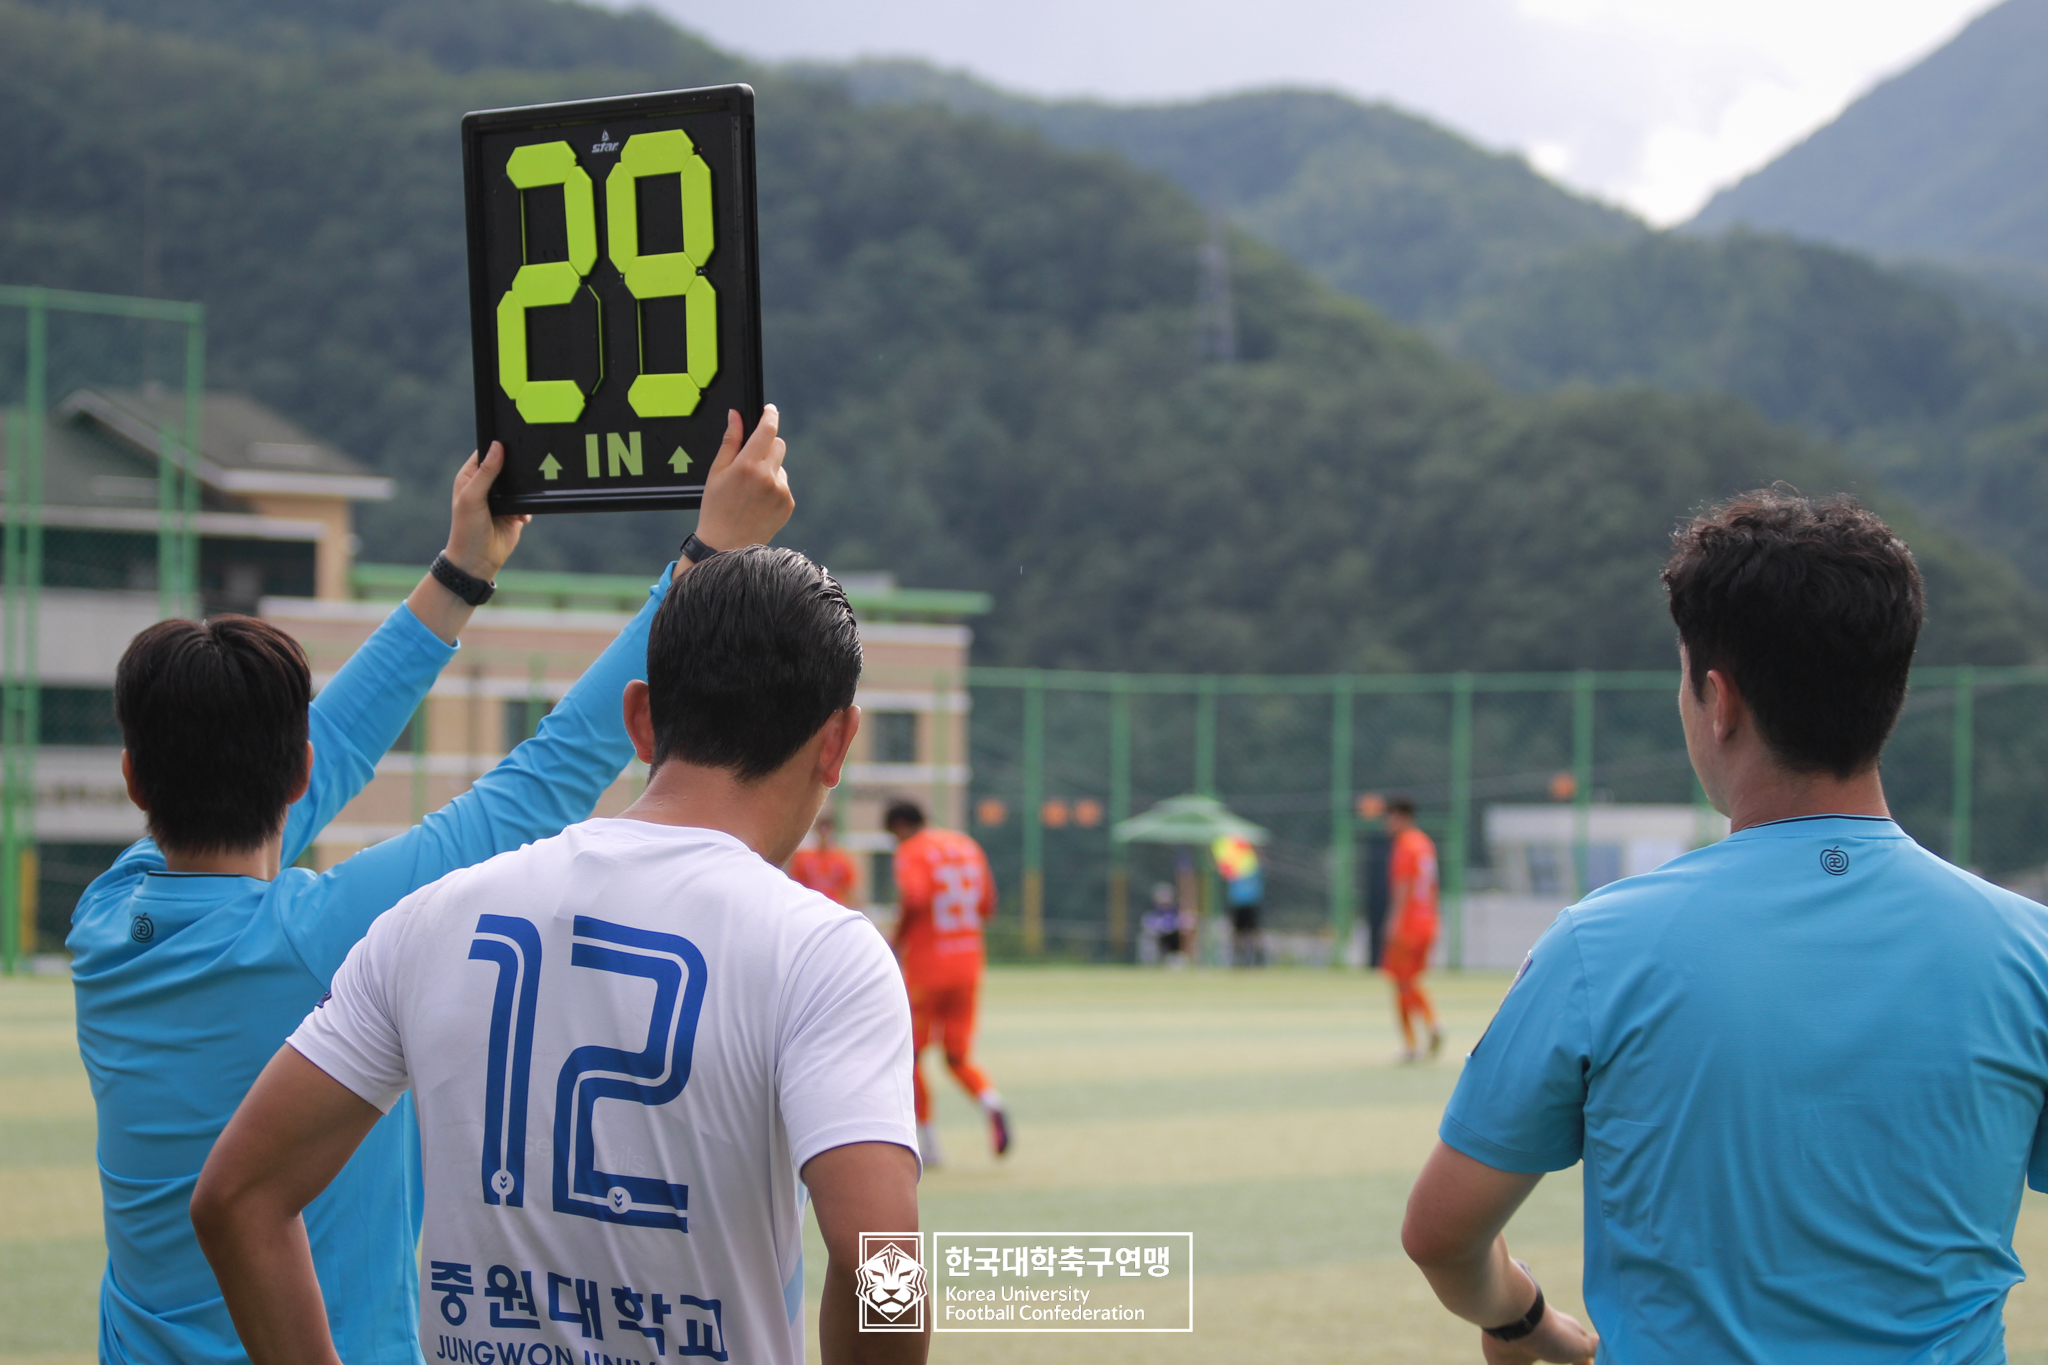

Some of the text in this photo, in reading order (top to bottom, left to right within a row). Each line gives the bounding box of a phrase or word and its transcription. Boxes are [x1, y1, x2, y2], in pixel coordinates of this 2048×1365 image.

[591, 142, 619, 153] star
[497, 128, 718, 424] 29
[585, 431, 643, 478] IN
[468, 914, 708, 1233] 12
[430, 1260, 729, 1362] 중원대학교
[436, 1335, 574, 1365] JUNGWON
